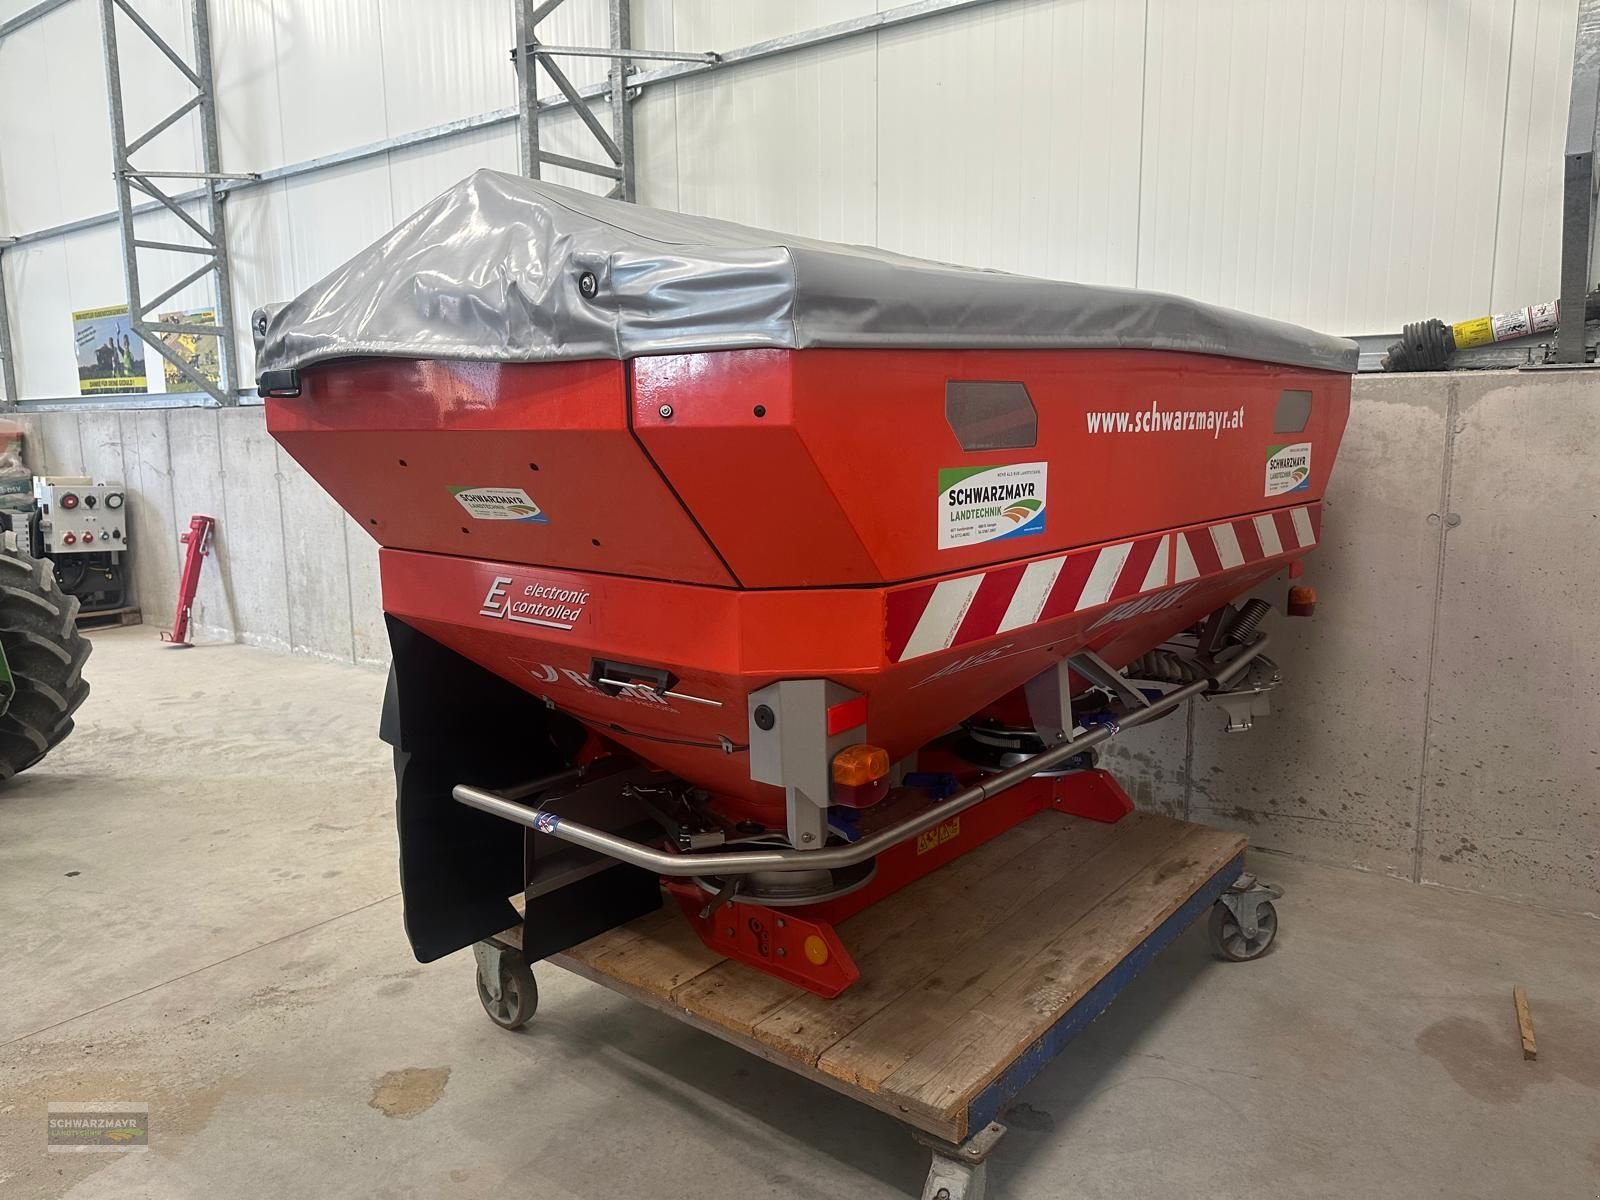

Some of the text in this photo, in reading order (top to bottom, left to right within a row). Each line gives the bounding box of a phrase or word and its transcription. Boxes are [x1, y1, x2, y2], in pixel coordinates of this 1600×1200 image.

[1086, 400, 1245, 439] www.schwarzmayr.at
[1270, 456, 1306, 470] SCHWARZMAYR
[459, 493, 525, 505] SCHWARZMAYR
[948, 483, 1035, 506] SCHWARZMAYR
[950, 506, 1002, 522] LANDTECHNIK
[524, 582, 590, 605] electronic
[512, 601, 582, 622] controlled
